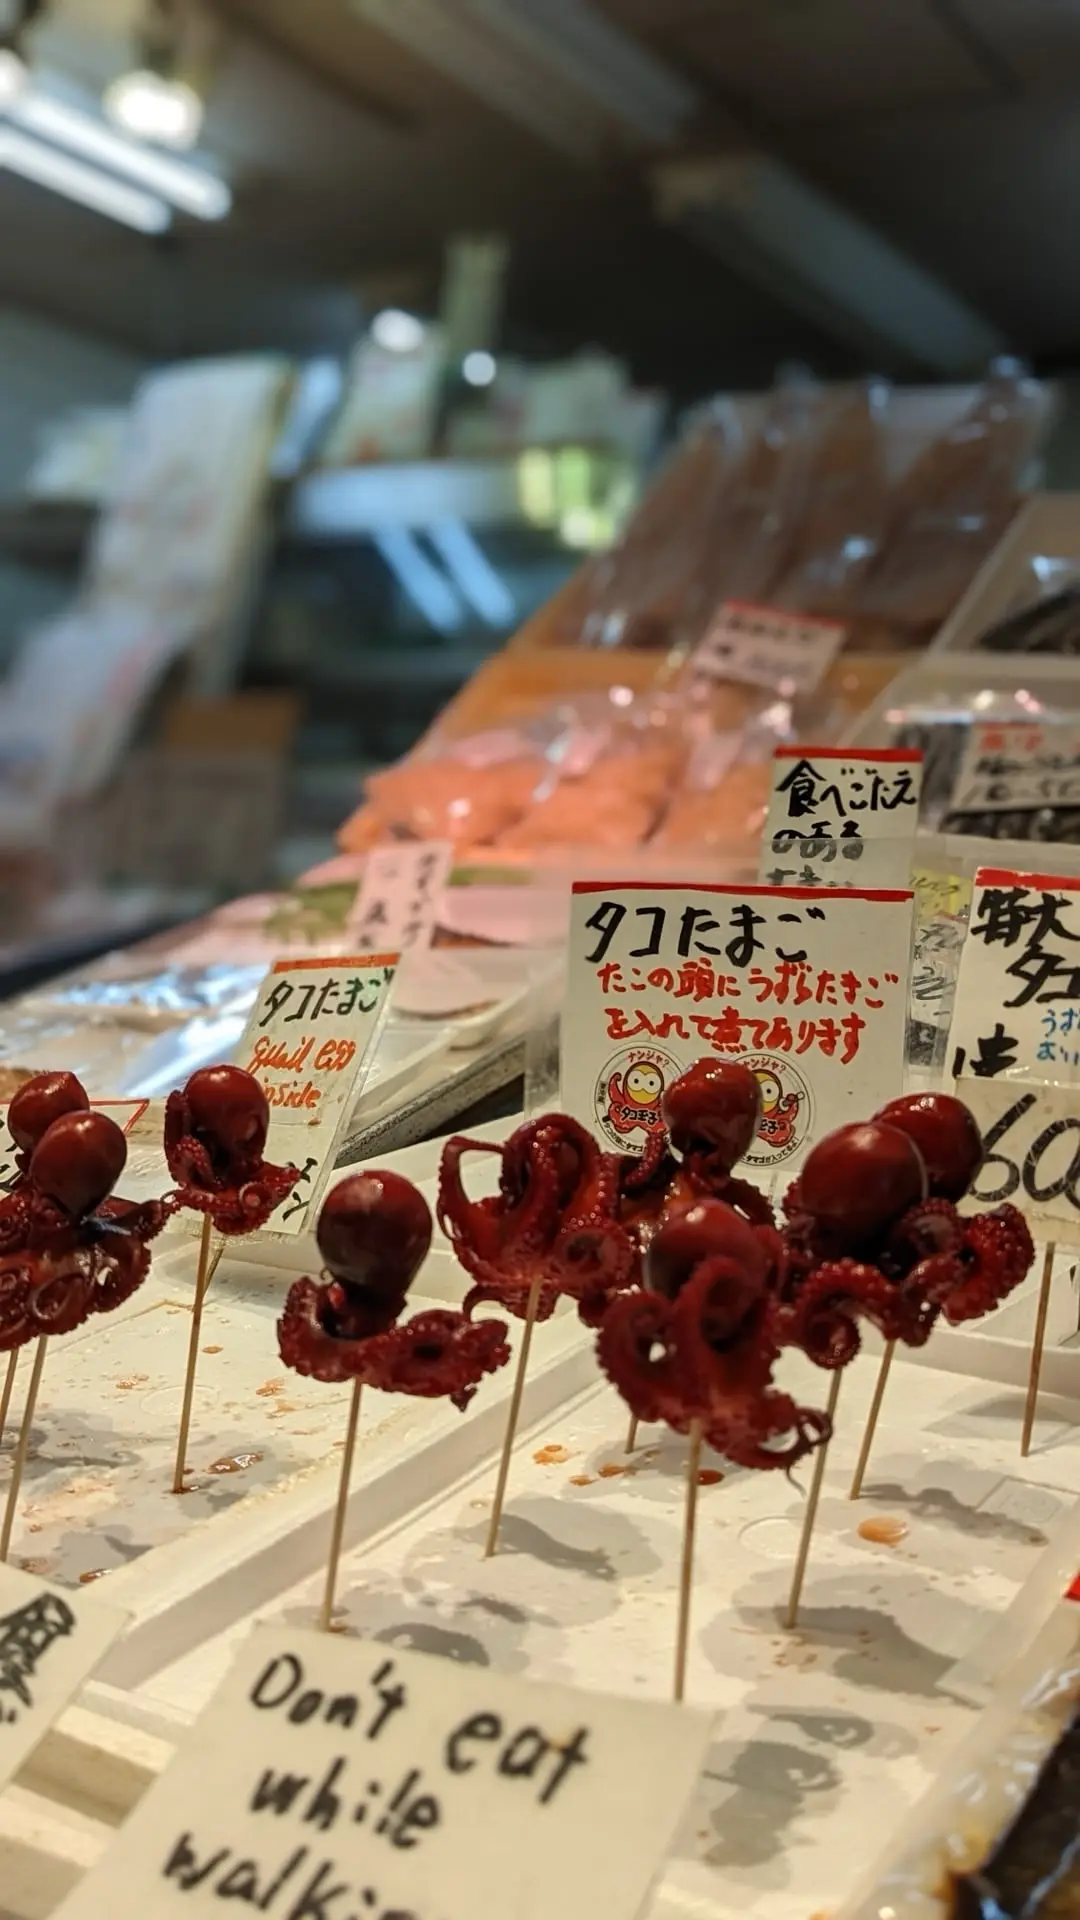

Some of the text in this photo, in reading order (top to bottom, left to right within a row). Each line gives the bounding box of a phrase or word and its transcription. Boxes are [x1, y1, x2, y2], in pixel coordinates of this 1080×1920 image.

[775, 759, 918, 818] 食べごたえ
[771, 820, 865, 863] のある
[585, 901, 826, 968] タコたまご
[259, 967, 395, 1028] タコたまご
[597, 957, 899, 1009] たこの頭にうずらたまご
[604, 1005, 866, 1064] を入れて煮てあります
[968, 1093, 1080, 1210] 60
[249, 1651, 590, 1804] Don't eat
[249, 1755, 442, 1850] while
